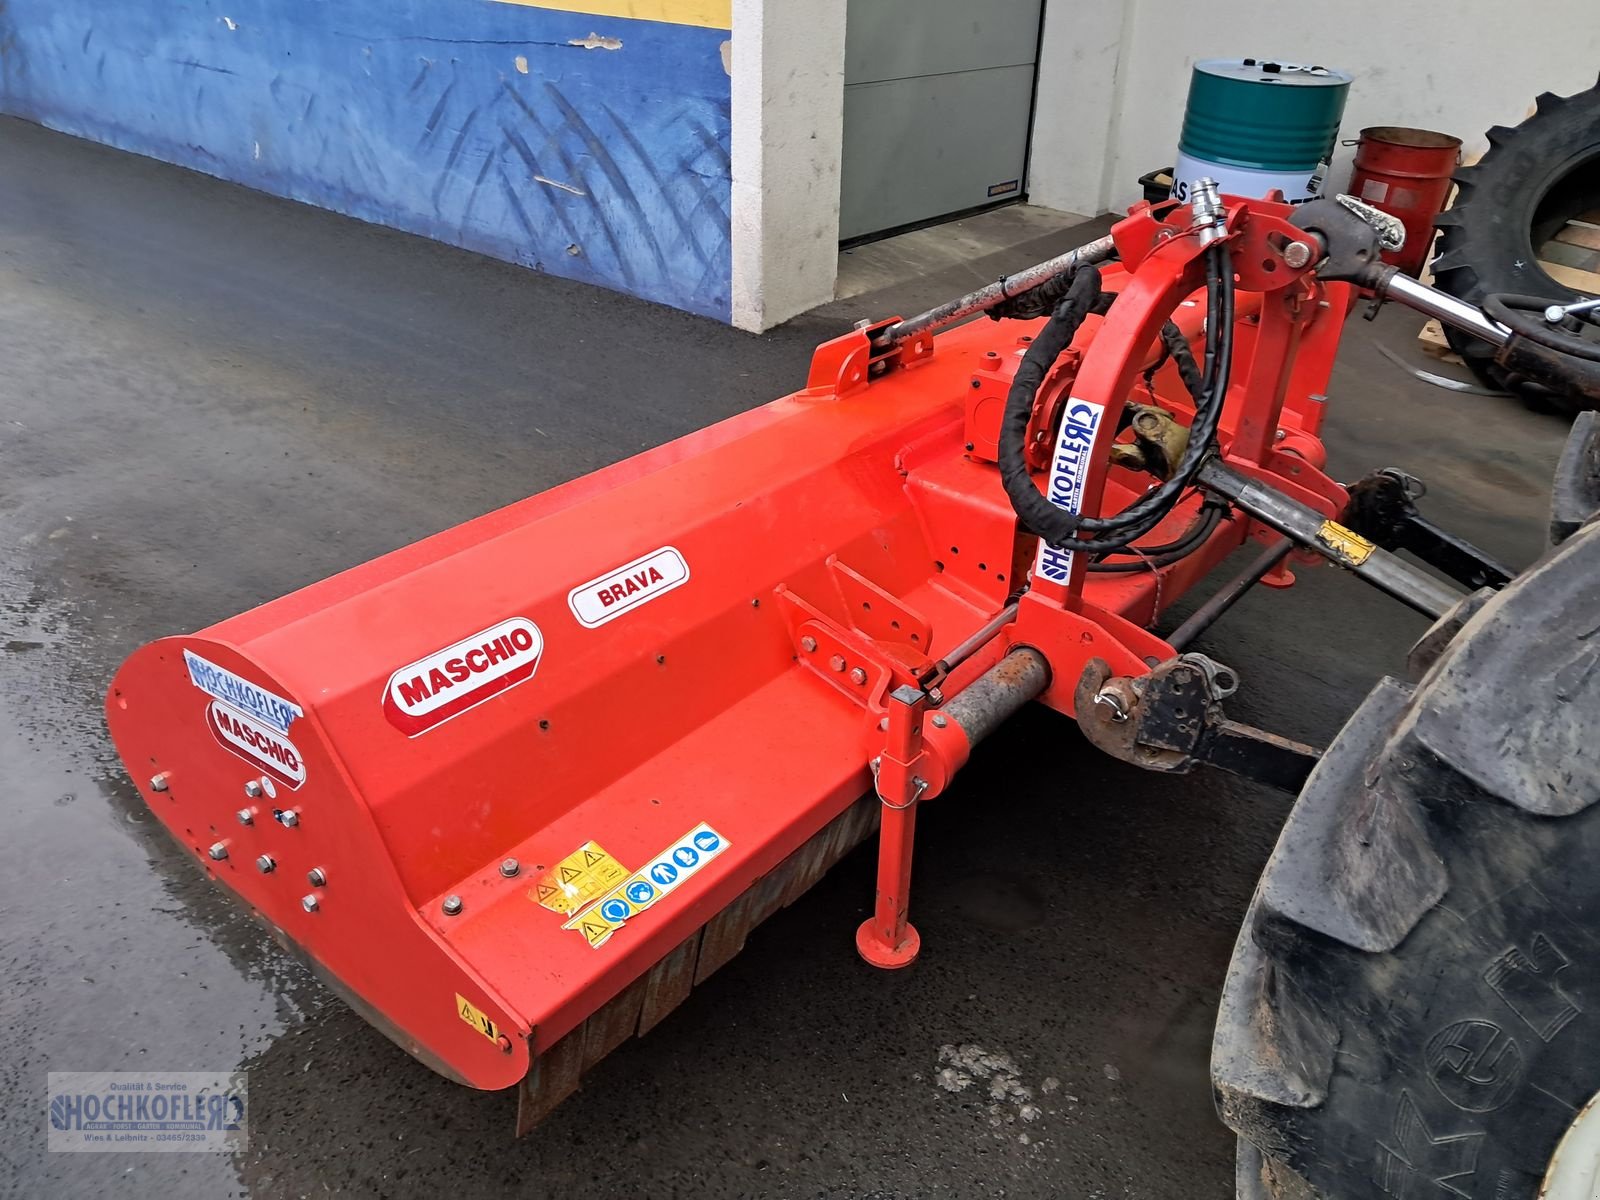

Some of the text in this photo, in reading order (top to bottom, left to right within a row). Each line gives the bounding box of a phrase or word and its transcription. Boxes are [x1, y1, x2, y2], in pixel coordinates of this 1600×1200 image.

[1041, 420, 1094, 568] HKOFLER
[597, 567, 664, 607] BRAVA
[397, 628, 533, 707] MASCHIO
[215, 708, 299, 772] MASCHIO
